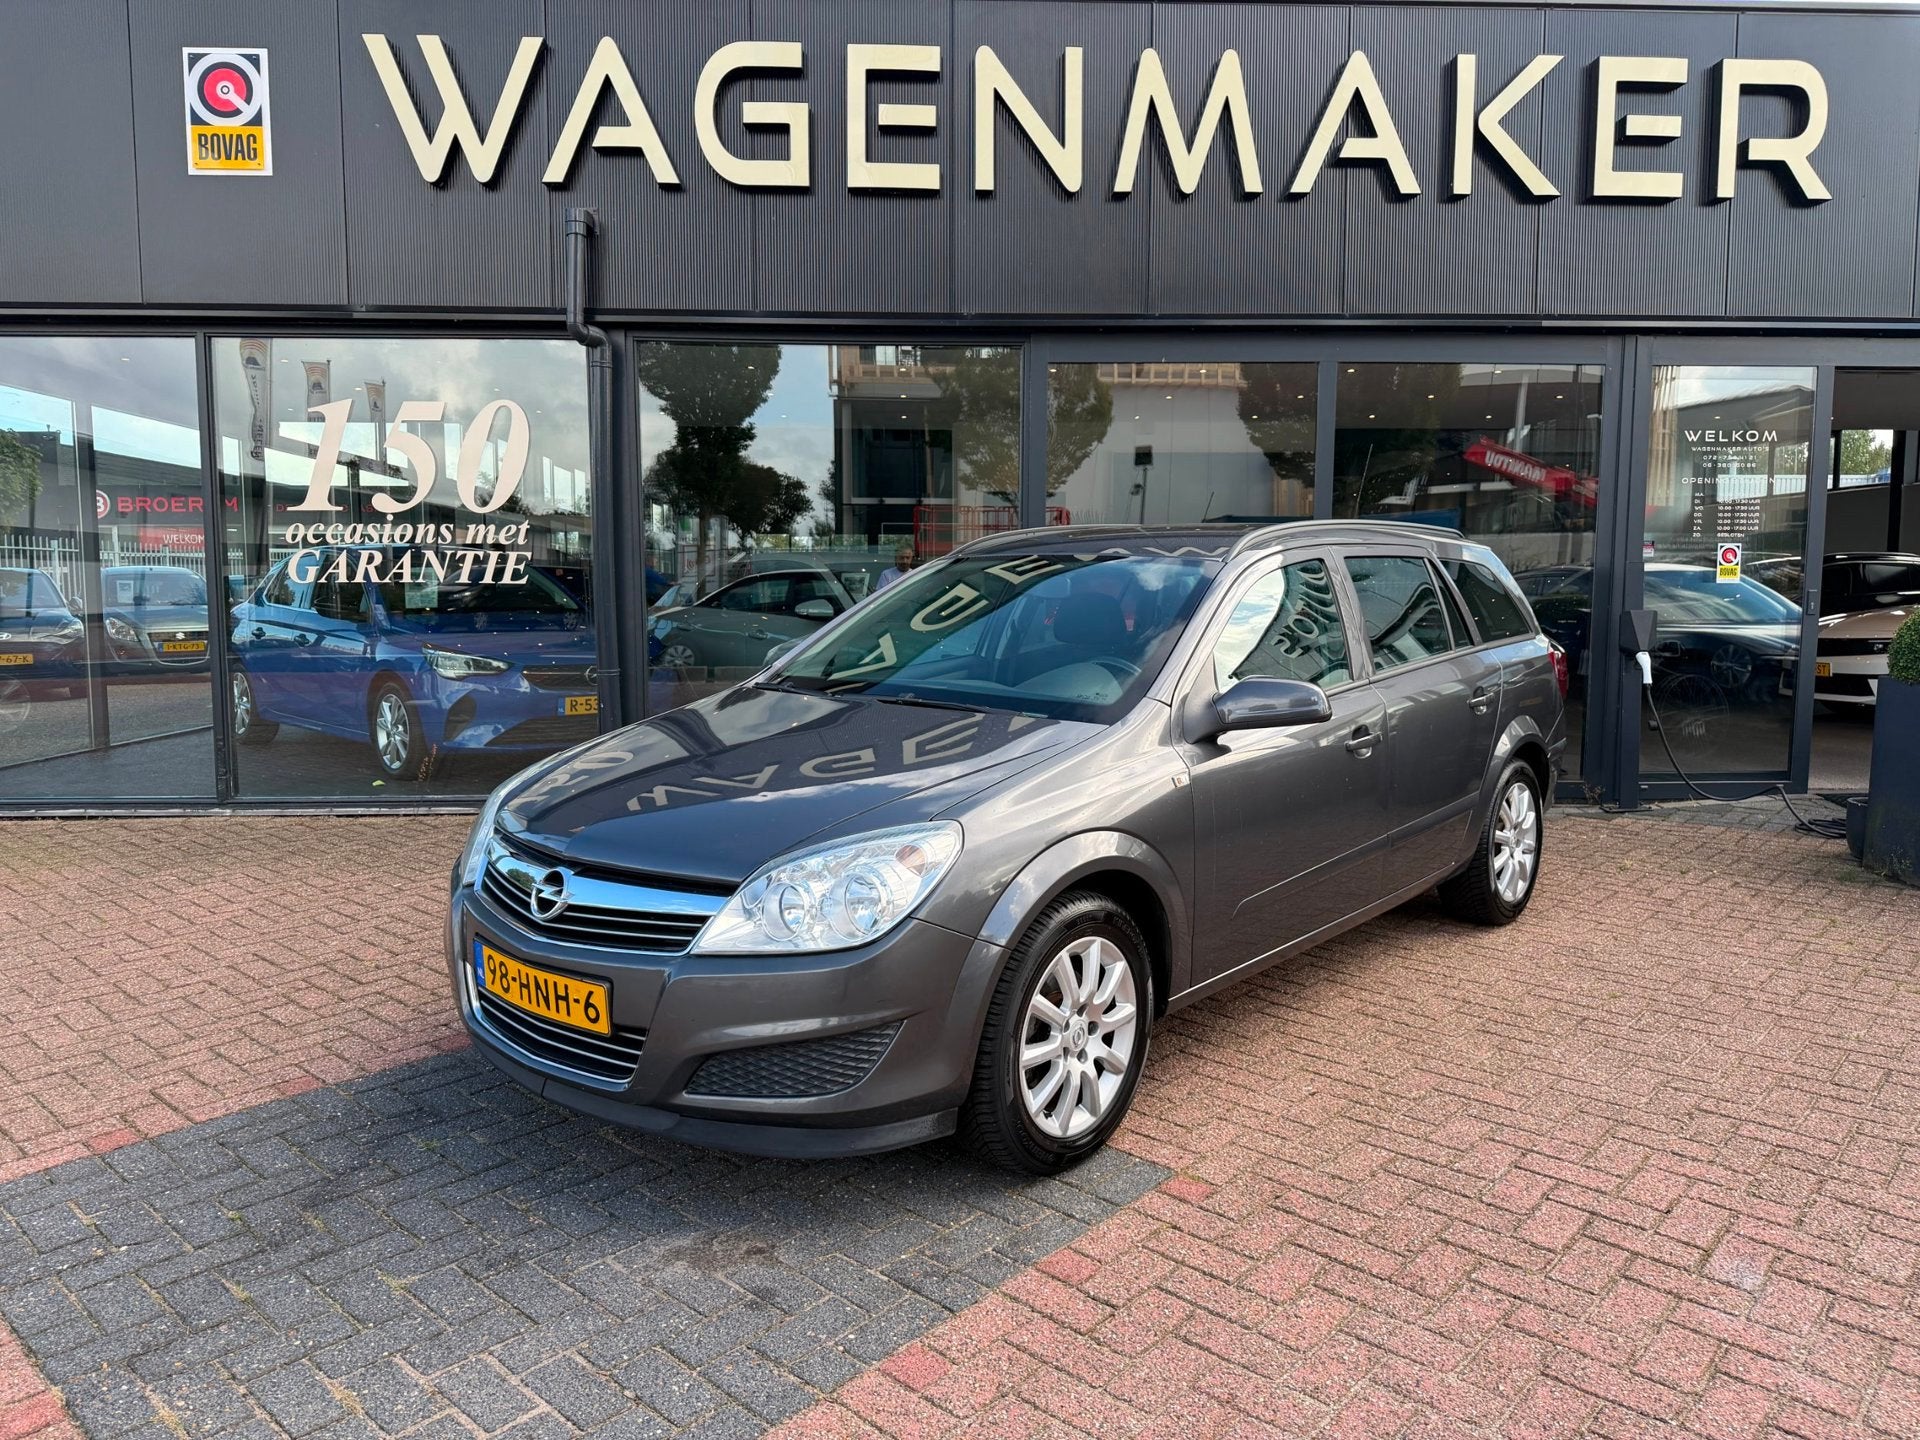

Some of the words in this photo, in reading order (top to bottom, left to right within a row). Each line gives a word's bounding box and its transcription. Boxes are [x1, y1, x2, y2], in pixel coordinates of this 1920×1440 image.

[362, 33, 1832, 201] WAGENMAKER
[197, 133, 258, 161] BOVAG
[1684, 429, 1778, 442] WELKOM
[287, 398, 531, 514] 150
[285, 514, 454, 545] occasions
[465, 519, 531, 546] met
[287, 549, 533, 585] GARANTIE
[487, 954, 601, 1024] 98-HNH-6
